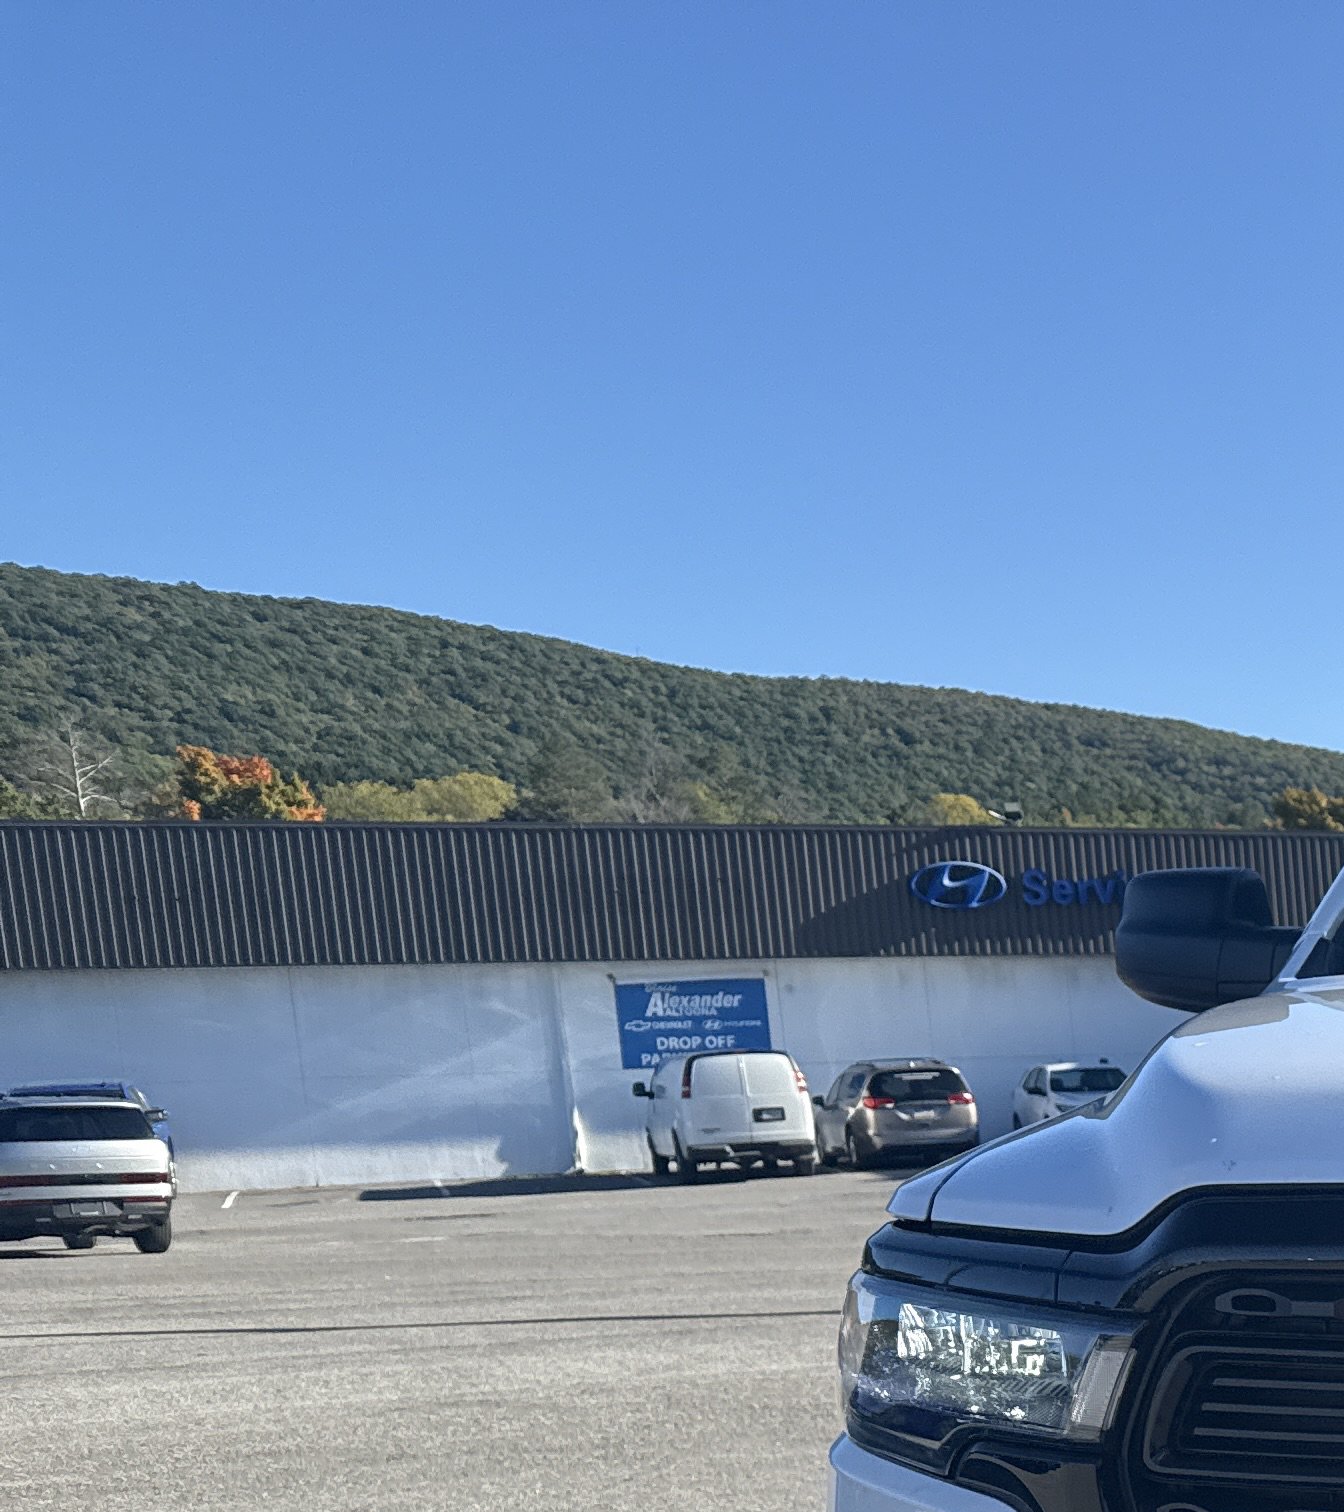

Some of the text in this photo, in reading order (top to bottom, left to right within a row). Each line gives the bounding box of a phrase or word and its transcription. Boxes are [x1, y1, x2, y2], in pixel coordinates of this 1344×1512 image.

[645, 991, 743, 1017] Alexander
[656, 1035, 736, 1050] DROP OFF
